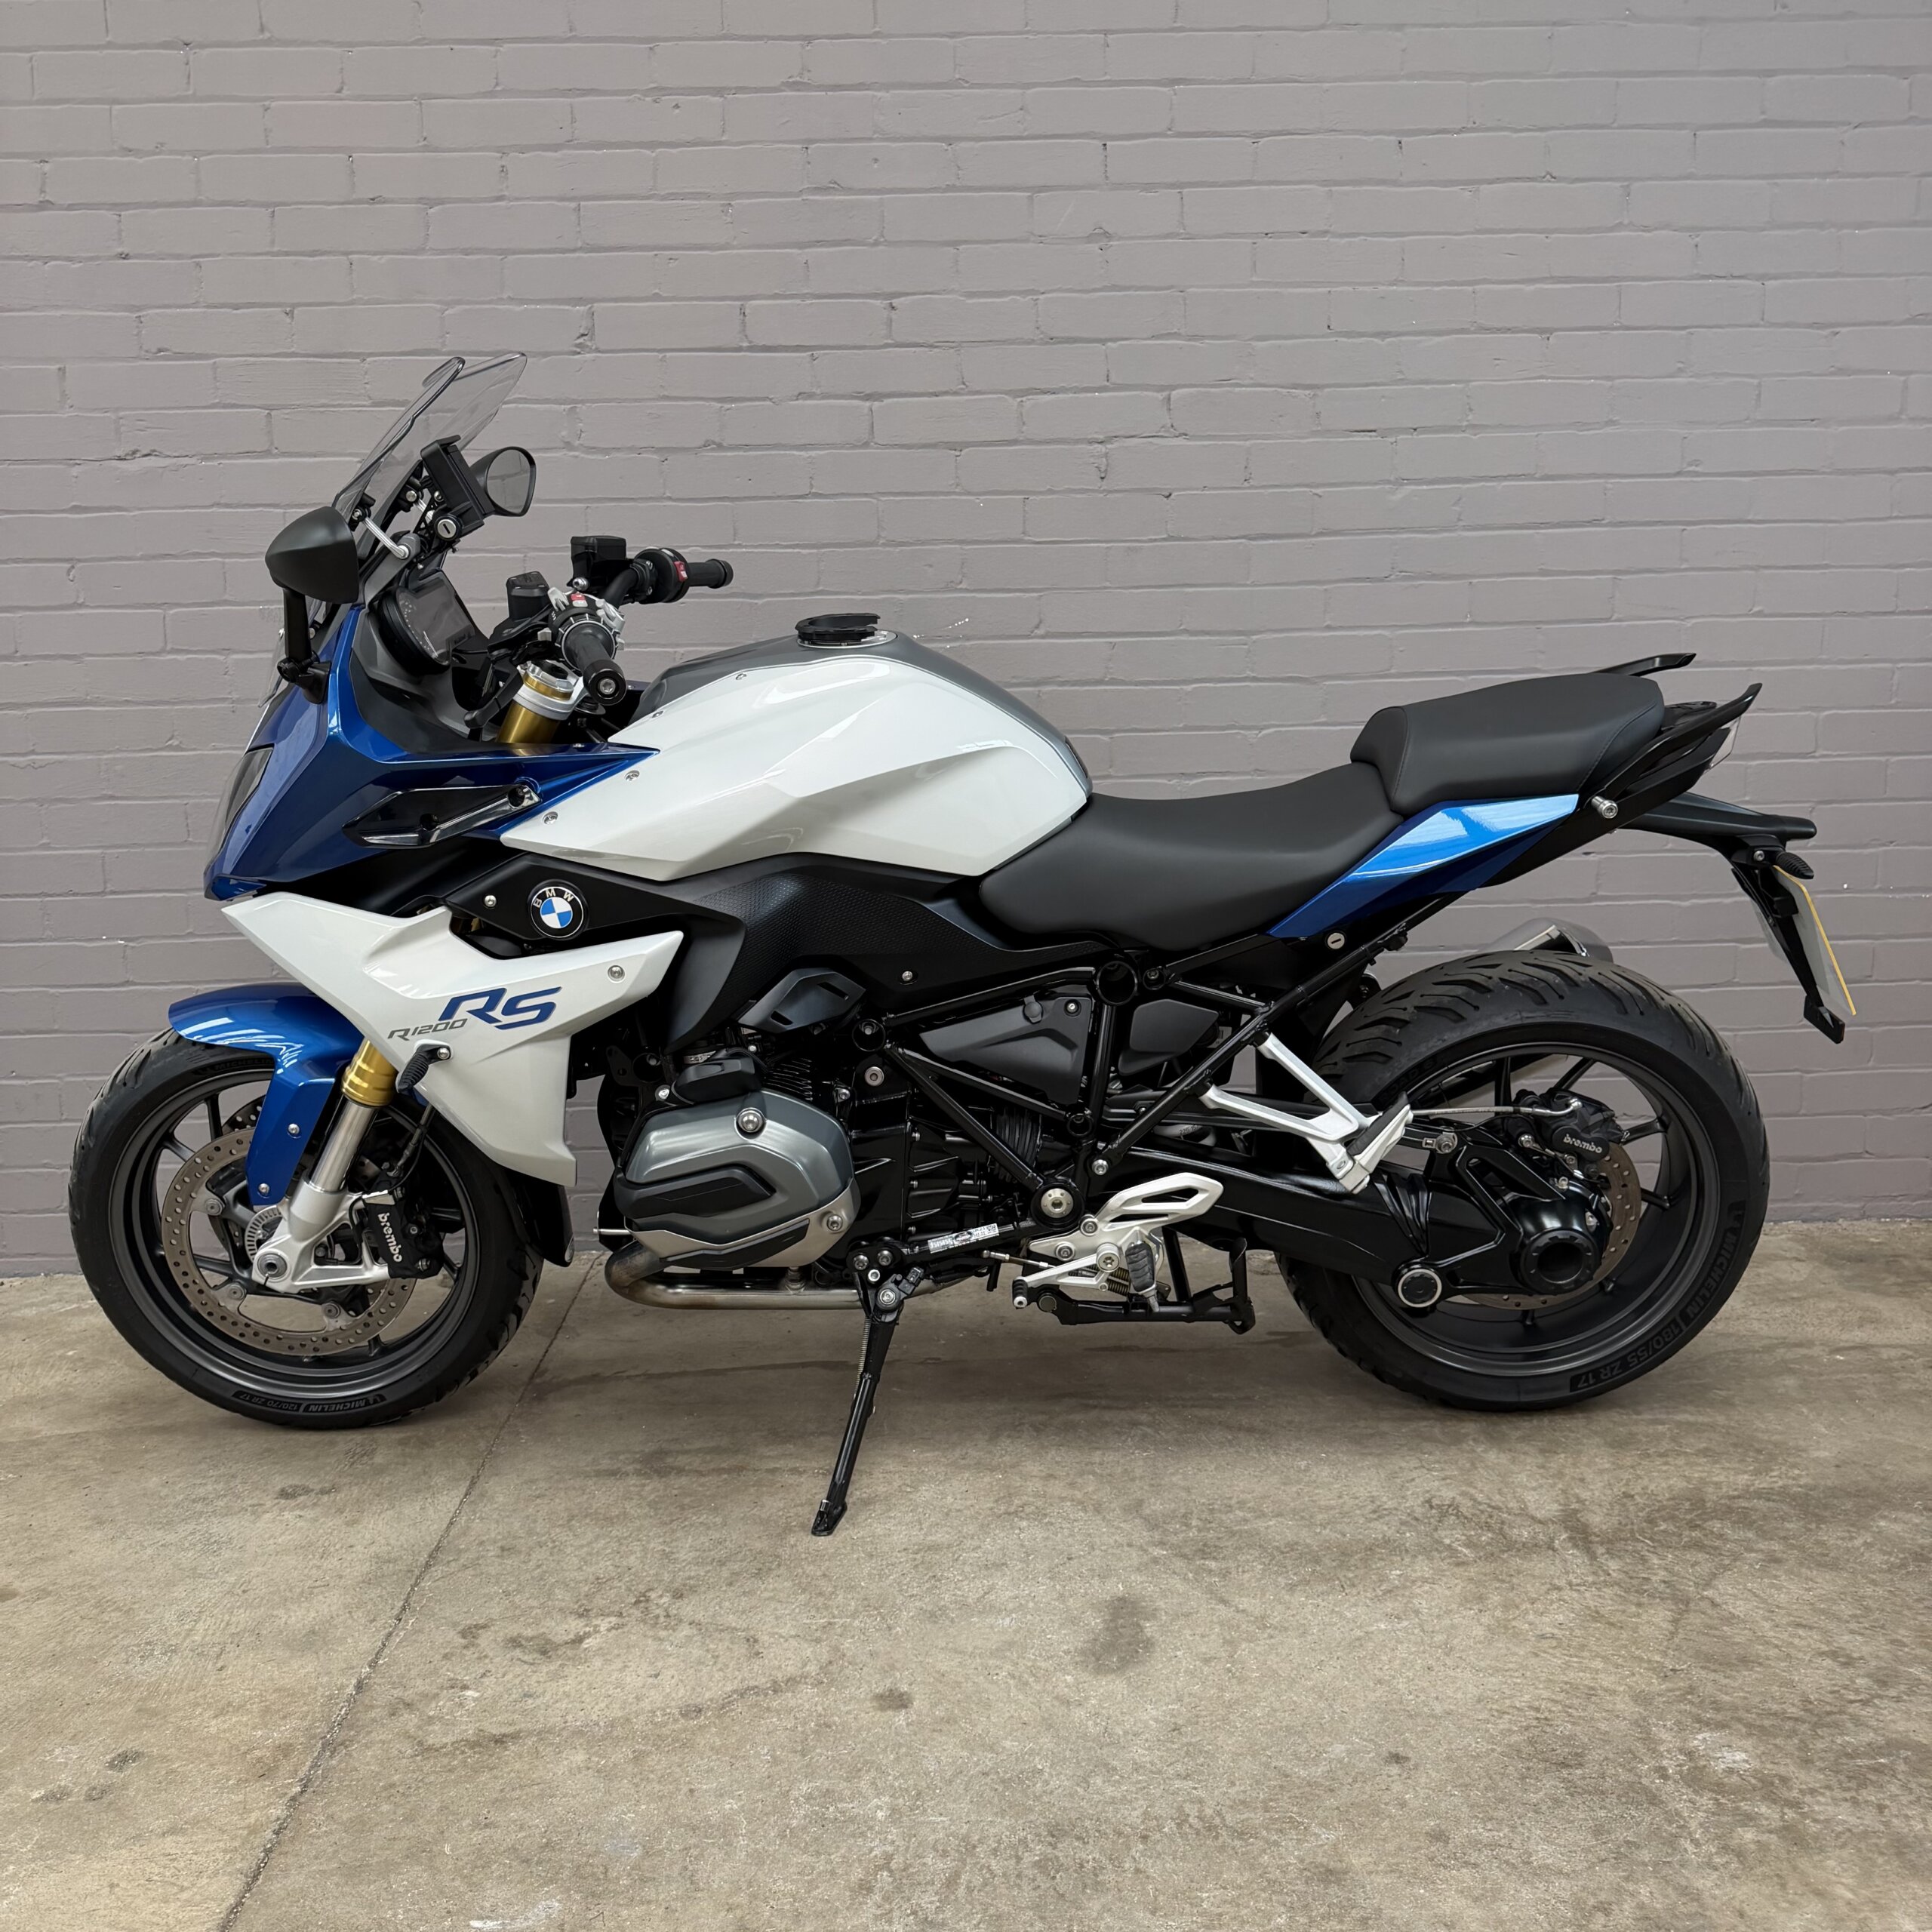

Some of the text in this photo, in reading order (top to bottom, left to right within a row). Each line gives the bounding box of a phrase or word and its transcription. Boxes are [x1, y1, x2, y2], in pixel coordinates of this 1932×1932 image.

[532, 888, 574, 909] BMW
[438, 986, 562, 1030] RS
[387, 1018, 468, 1041] R1200
[1562, 1134, 1603, 1154] brembo
[377, 1212, 403, 1263] brembo
[1685, 1230, 1738, 1319] MICHELIN
[1578, 1323, 1680, 1388] 180/55 ZR 17
[251, 1396, 266, 1405] ZR
[266, 1400, 298, 1411] 120/70
[308, 1398, 366, 1412] MICHELIN
